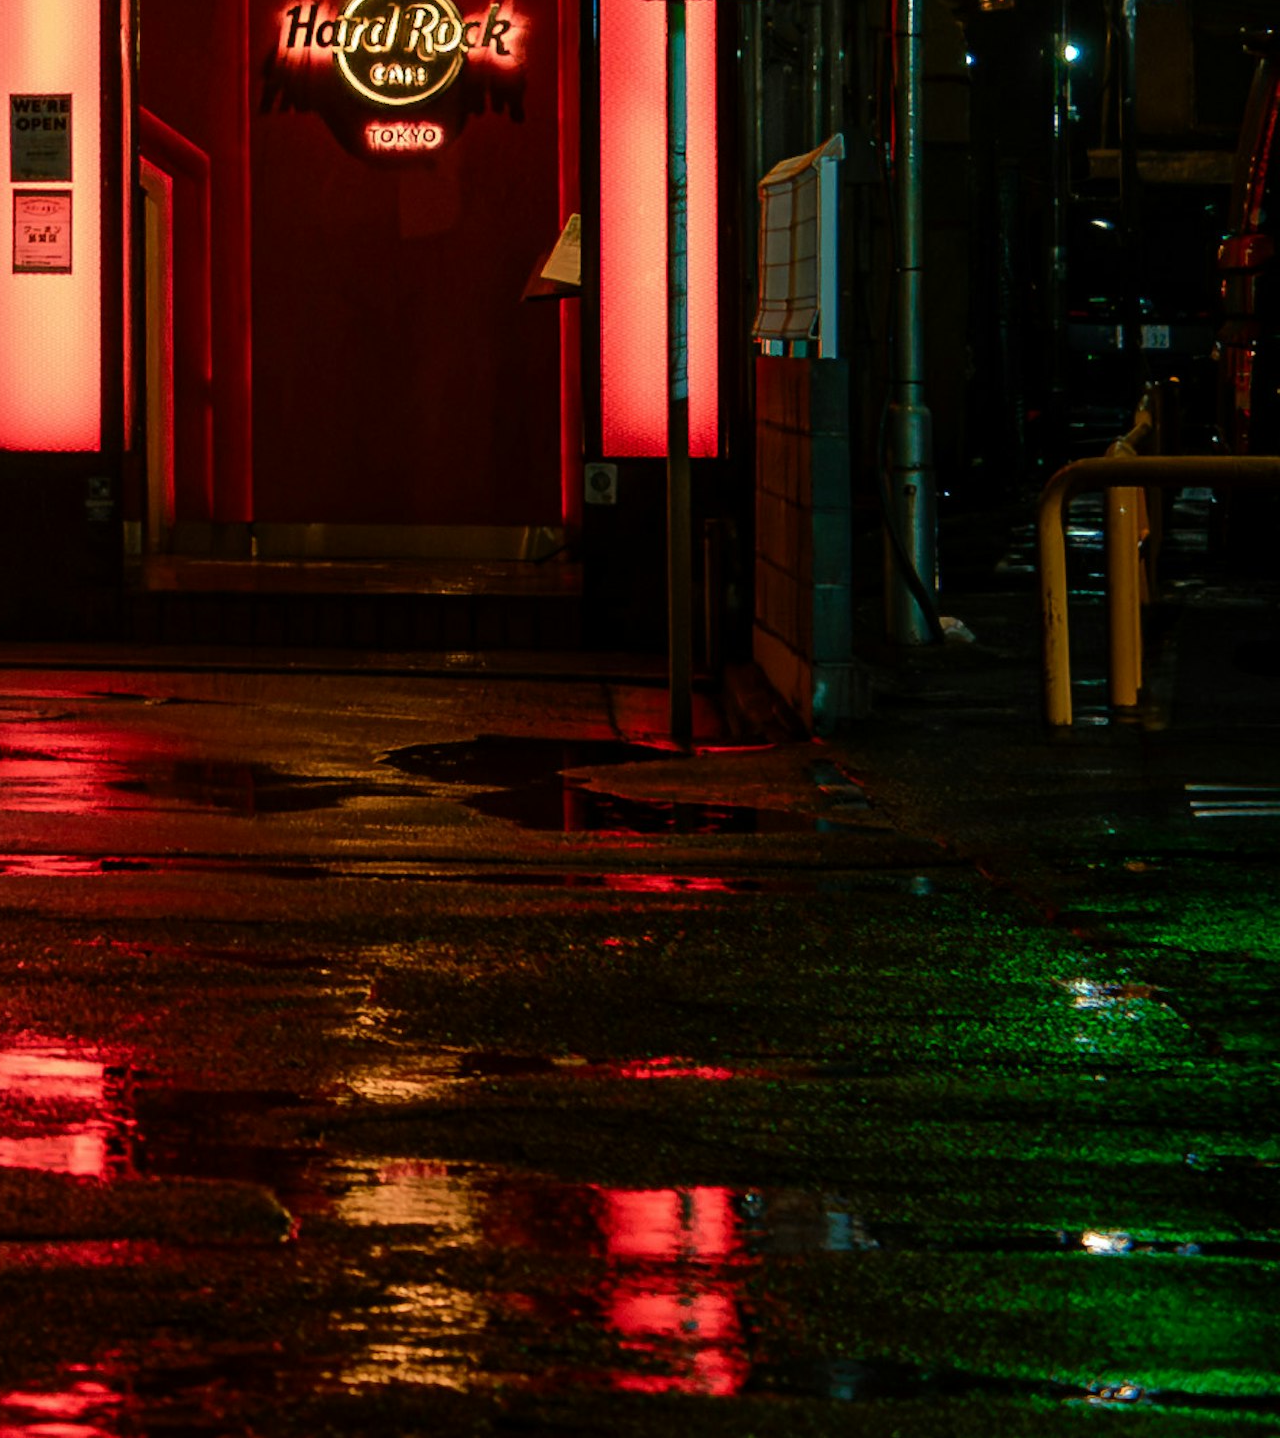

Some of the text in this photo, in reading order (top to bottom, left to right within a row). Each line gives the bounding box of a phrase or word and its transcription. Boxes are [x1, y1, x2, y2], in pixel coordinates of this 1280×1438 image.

[285, 2, 512, 62] Hard Rock
[13, 99, 70, 114] WE'RE
[15, 117, 67, 132] OPEN
[369, 128, 436, 143] TOKYO
